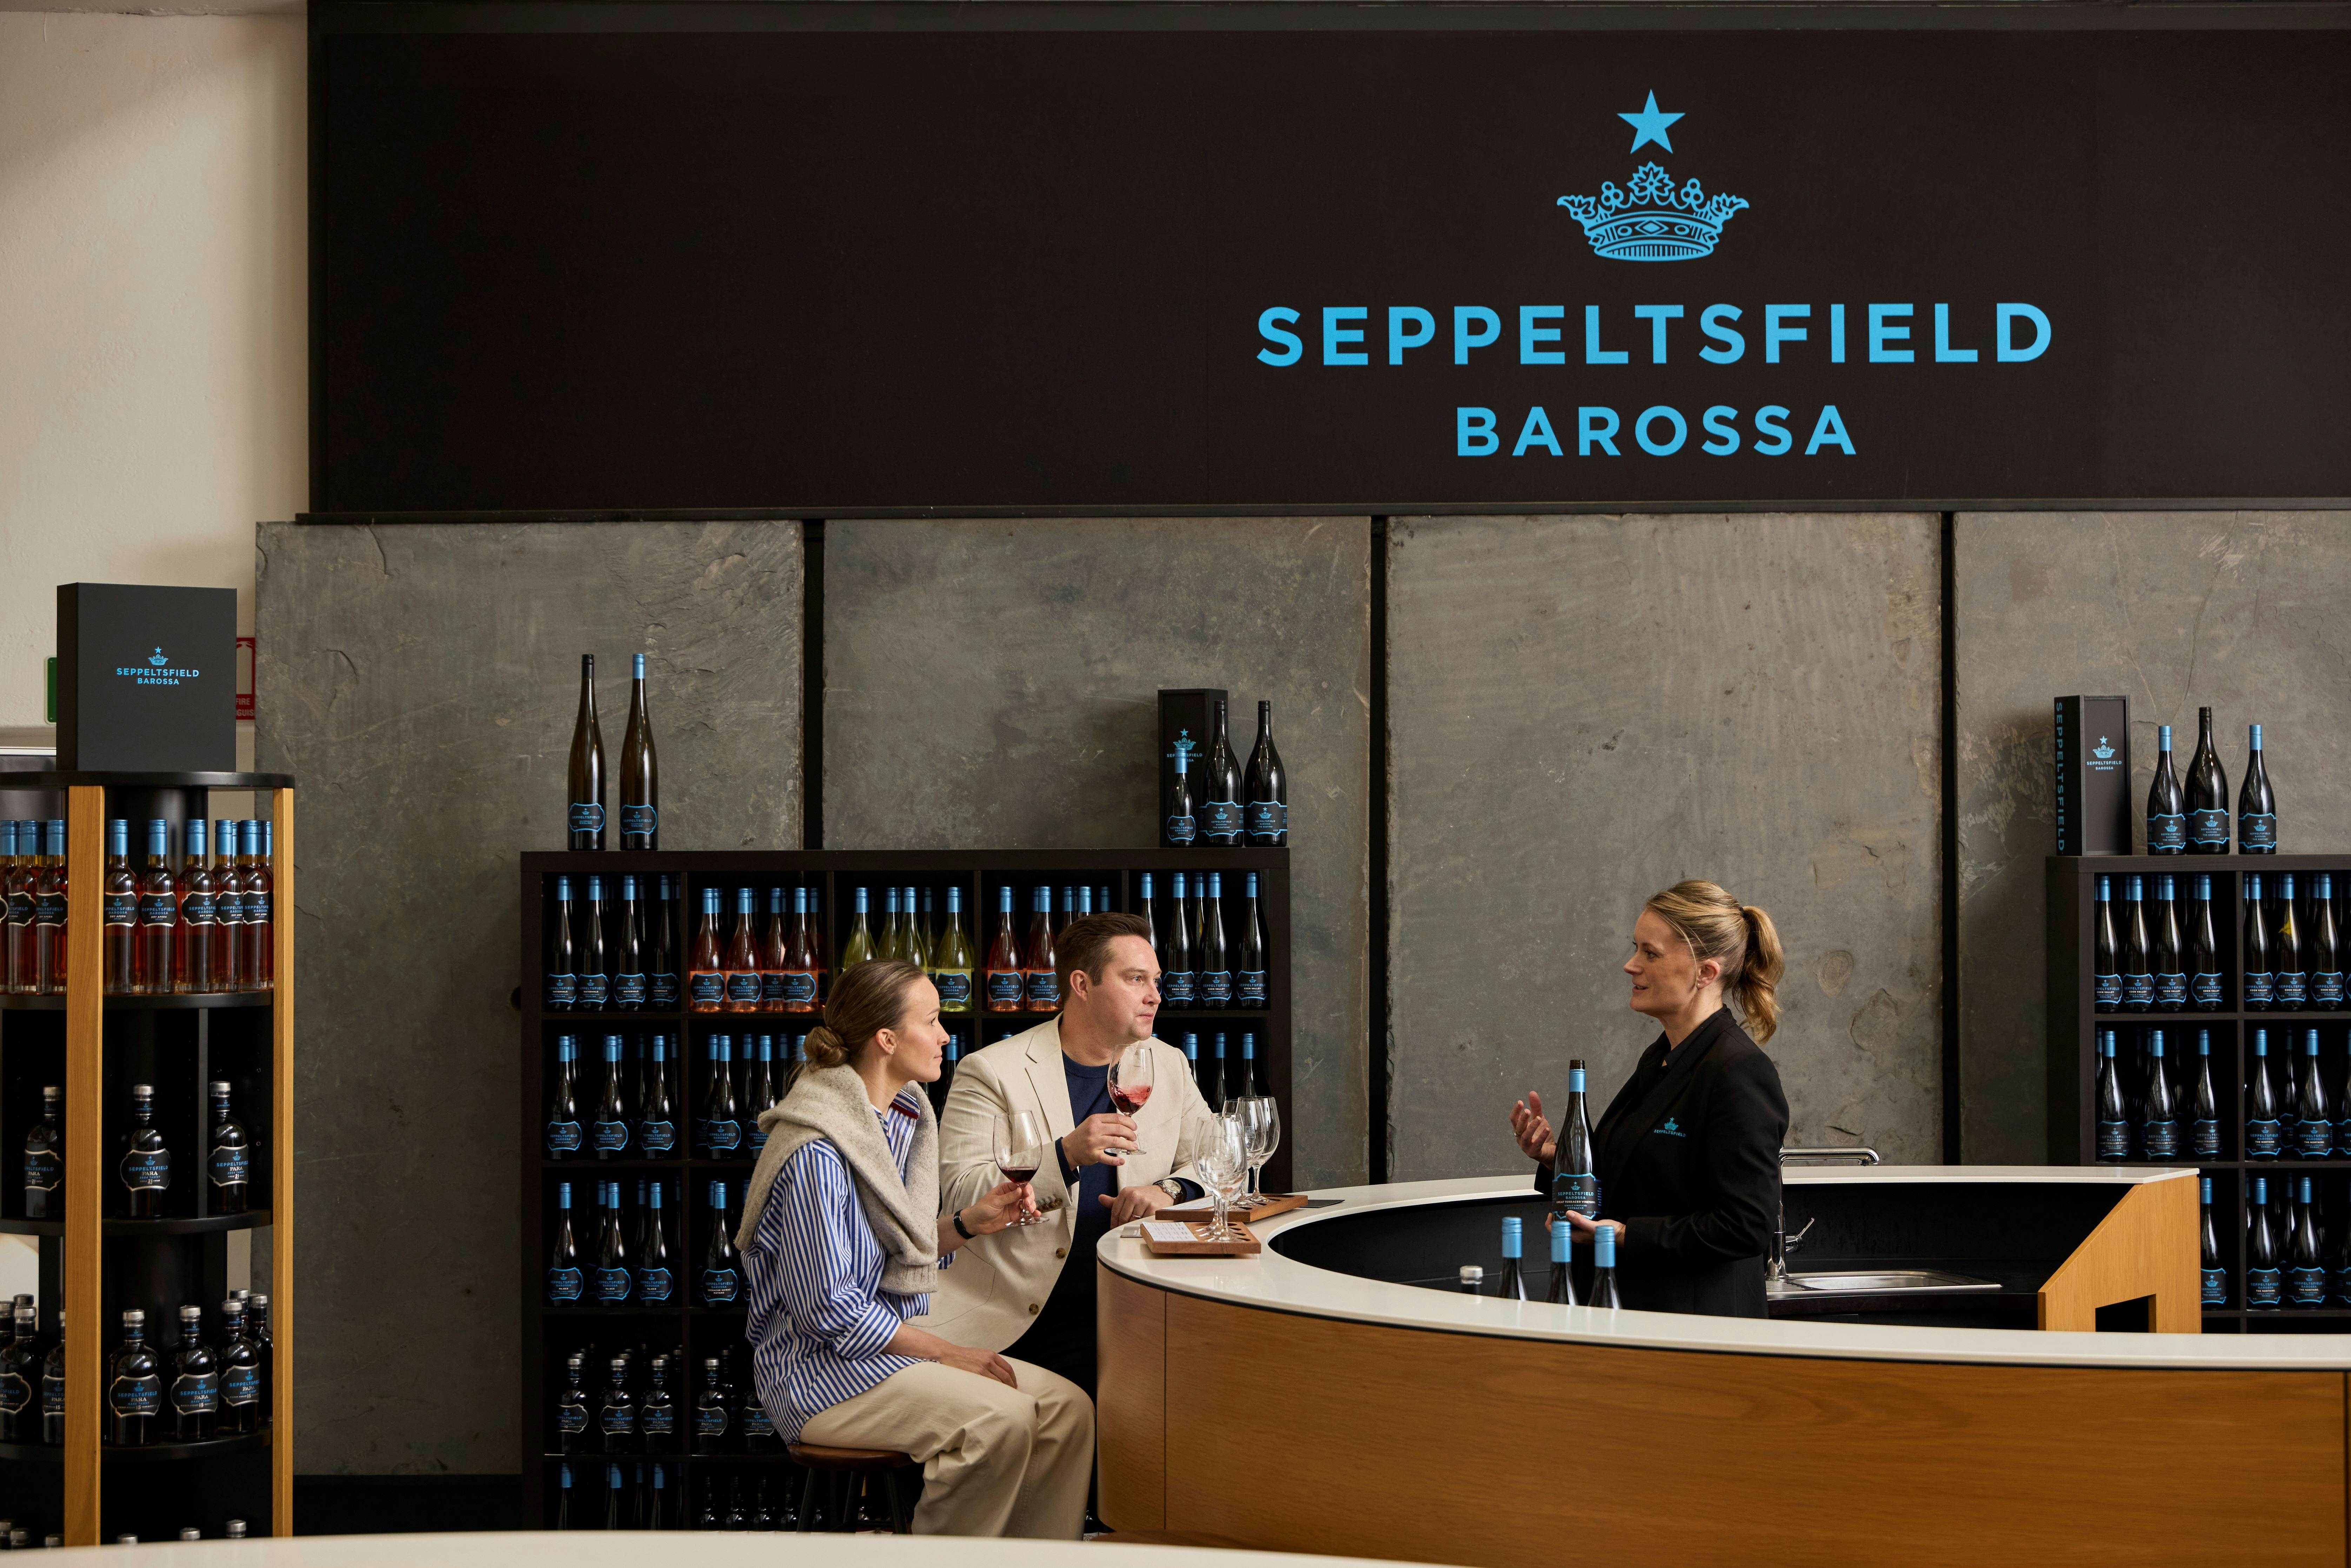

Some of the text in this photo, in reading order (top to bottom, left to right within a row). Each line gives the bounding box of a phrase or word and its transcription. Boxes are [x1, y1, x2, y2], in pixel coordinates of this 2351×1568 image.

[1257, 303, 2051, 366] SEPPELTSFIELD
[1457, 406, 1856, 456] BAROSSA
[117, 668, 199, 677] SEPPELTSFIELD
[2056, 702, 2064, 852] SEPPELTSFIELD
[1654, 1129, 1686, 1137] SEPPELTSFIELD
